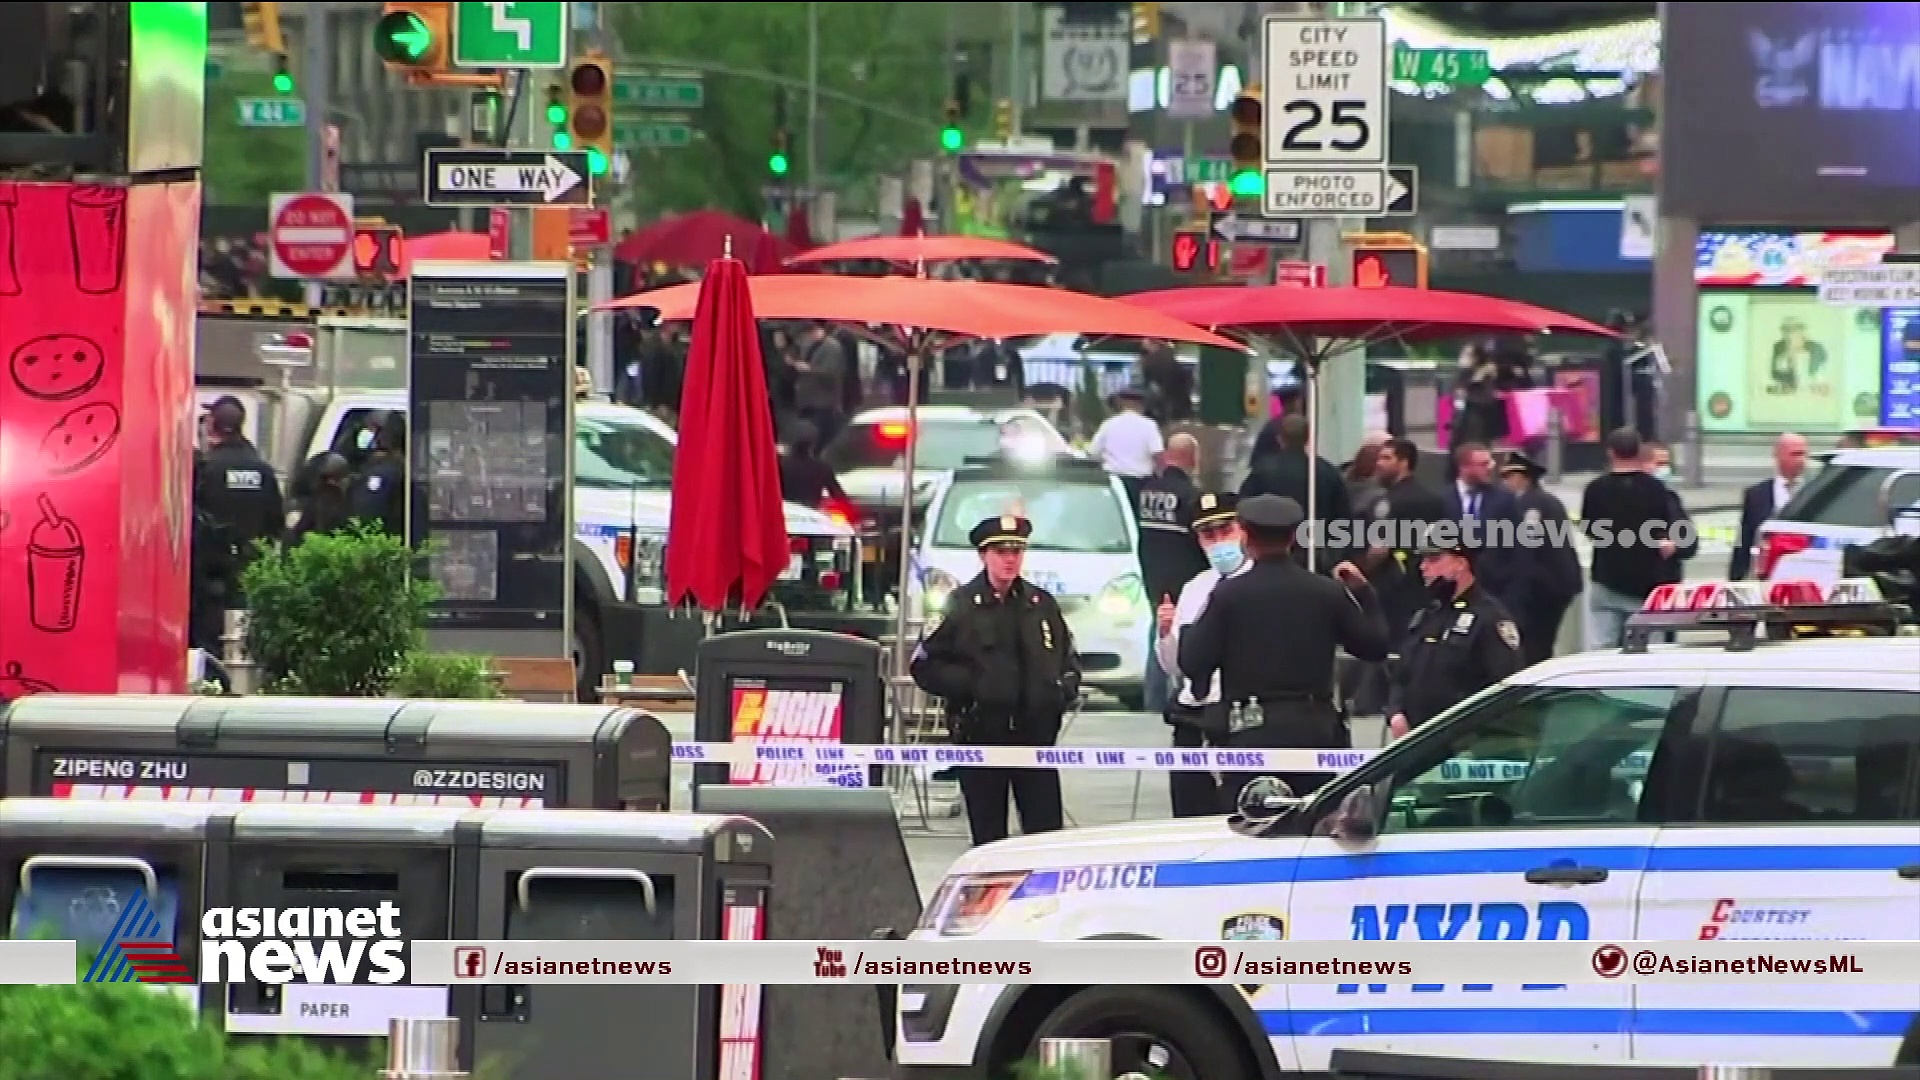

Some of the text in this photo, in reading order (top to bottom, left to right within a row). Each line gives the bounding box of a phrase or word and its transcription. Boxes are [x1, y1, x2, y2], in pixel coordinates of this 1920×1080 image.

[1300, 27, 1347, 44] CITY
[1289, 50, 1358, 66] SPEED
[1400, 52, 1419, 77] W
[1431, 53, 1460, 79] 45
[1296, 74, 1350, 90] LIMIT
[1282, 100, 1369, 151] 25
[451, 167, 565, 189] ONE WAY
[1294, 176, 1355, 191] PHOTO
[1275, 192, 1374, 207] ENFORCED
[756, 747, 804, 760] POLICE
[816, 748, 845, 760] LINE
[875, 749, 894, 761] DO
[901, 749, 928, 761] NOT
[935, 749, 985, 763] CROSS
[1036, 751, 1085, 764] POLICE
[1096, 752, 1126, 765] LINE
[1155, 752, 1175, 766] DO
[1182, 752, 1209, 766] NOT
[1216, 752, 1265, 767] CROSS
[53, 758, 188, 780] ZIPENG ZHU
[1441, 763, 1462, 778] DO
[1468, 763, 1496, 778] NOT
[413, 769, 545, 790] @ZZDESIGN
[1060, 862, 1153, 893] POLICE
[301, 1003, 349, 1018] PAPER
